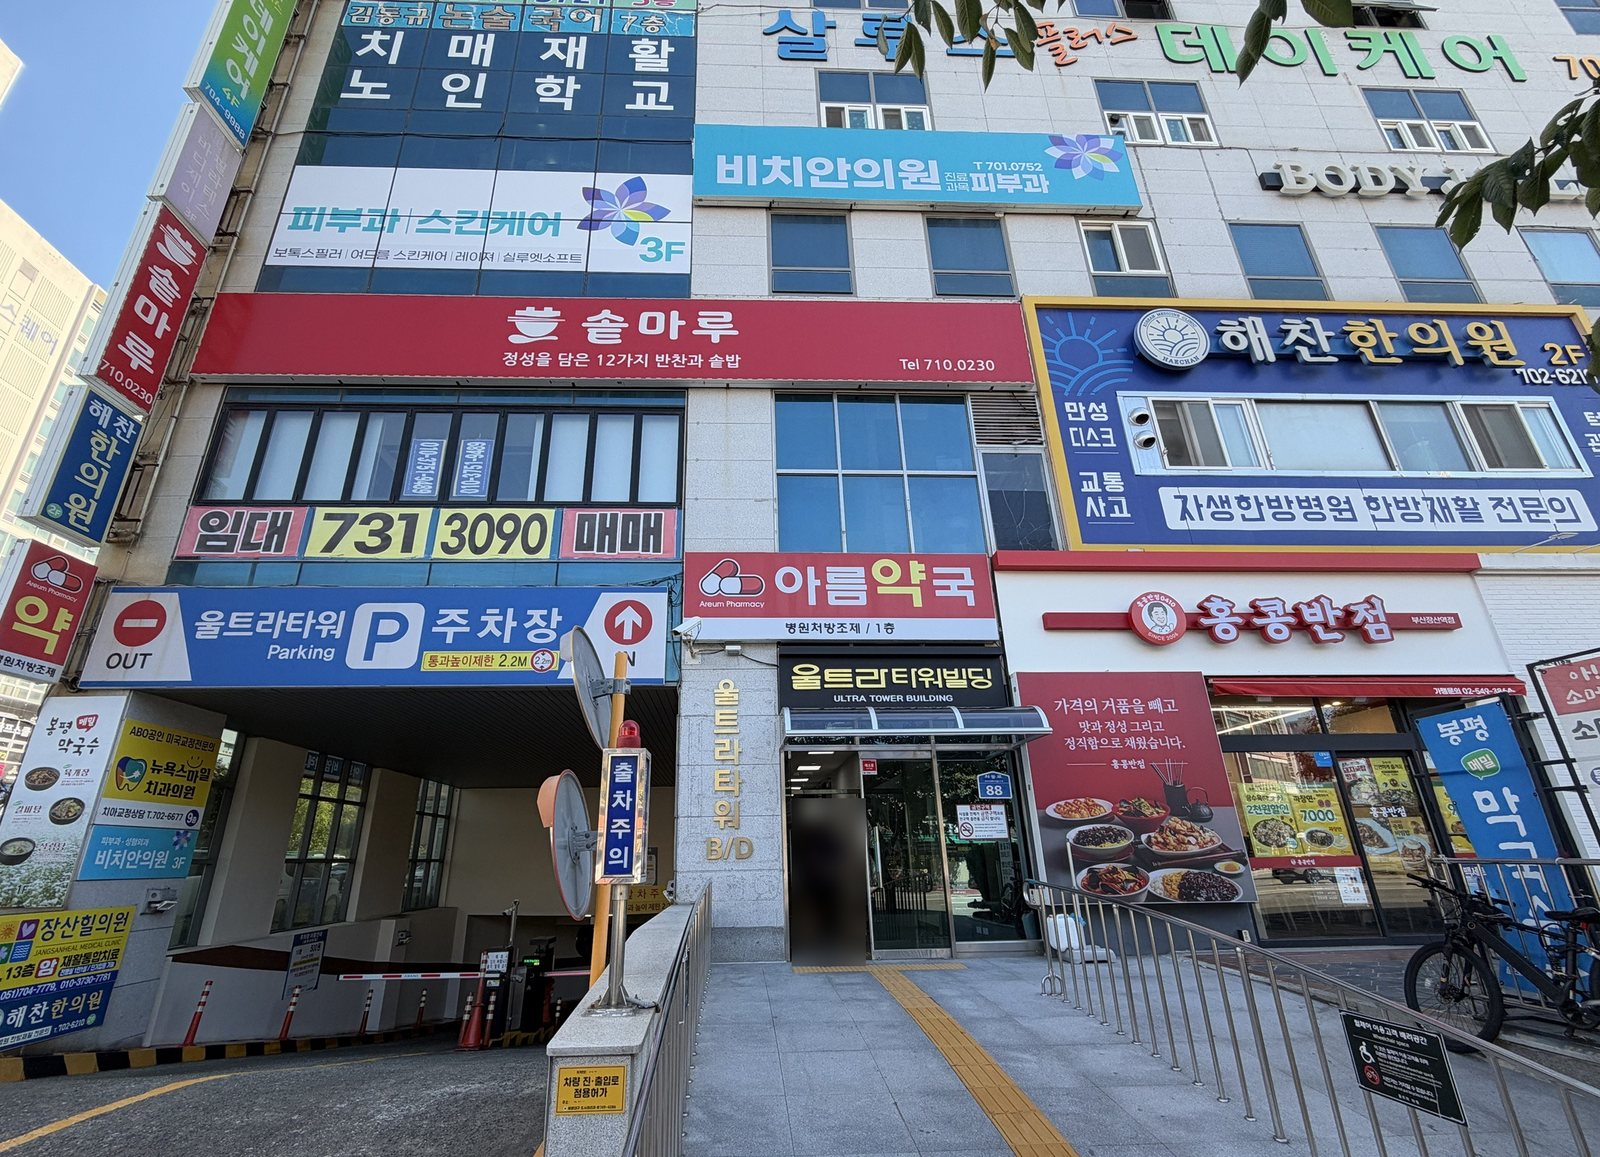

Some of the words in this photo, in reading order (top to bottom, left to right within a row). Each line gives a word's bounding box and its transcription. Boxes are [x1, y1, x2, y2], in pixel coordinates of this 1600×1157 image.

[620, 15, 667, 34] 7층
[1154, 23, 1527, 82] 데이케어
[222, 87, 241, 109] 4F
[716, 154, 941, 191] 비치안의원
[944, 172, 969, 182] 진료
[973, 161, 983, 171] T
[986, 161, 1044, 172] 701.0752
[970, 172, 1050, 194] 피부과
[1272, 160, 1432, 197] BODY
[287, 206, 400, 234] 피부과
[415, 208, 562, 238] 스킨케어
[273, 248, 343, 260] 보톡스필러
[393, 250, 448, 262] 스킨케어
[639, 236, 687, 263] 3F
[118, 264, 182, 375] 솥마루
[581, 308, 740, 345] 솥마루
[502, 351, 553, 367] 정성을
[557, 352, 591, 368] 담은
[597, 353, 649, 369] 12가지
[655, 353, 704, 369] 반찬과
[899, 358, 920, 371] Tel
[924, 359, 996, 372] 710.0230
[1541, 342, 1585, 366] 2F
[100, 359, 154, 405] 710.0230
[1064, 402, 1109, 422] 만성
[1069, 427, 1117, 447] 디스크
[1079, 471, 1124, 493] 교통
[1086, 496, 1131, 518] 사고
[1173, 494, 1358, 523] 자생한방병원
[1363, 495, 1485, 524] 한방재활
[1488, 496, 1582, 524] 전문의
[193, 509, 294, 555] 임대
[321, 511, 421, 555] 731
[440, 512, 549, 556] 3090
[573, 509, 667, 555] 매매
[774, 558, 976, 608] 아름약국
[699, 600, 725, 609] Areum
[726, 600, 765, 609] Pharmacy
[12, 595, 74, 655] 약
[194, 609, 347, 640] 울트라타워
[431, 607, 563, 645] 주차장
[785, 621, 861, 635] 병원처방조제
[876, 622, 895, 634] 1층
[1200, 594, 1395, 643] 홍콩반점
[366, 611, 411, 663] P
[105, 652, 154, 670] OUT
[266, 643, 336, 663] Parking
[427, 653, 494, 668] 통과높이제한
[498, 653, 528, 668] 2.2M
[791, 663, 993, 690] 울트라타워빌딩
[833, 693, 866, 703] ULTRA
[869, 693, 903, 703] TOWER
[906, 693, 954, 703] BUILDING
[1054, 697, 1098, 715] 가격의
[1102, 698, 1145, 715] 거품을
[1148, 698, 1179, 714] 빼고
[46, 717, 73, 736] 봉평
[78, 716, 97, 727] 메밀
[1078, 720, 1102, 734] 맛과
[1104, 720, 1127, 734] 정성
[1130, 720, 1165, 733] 그리고
[1438, 714, 1490, 746] 봉평
[58, 737, 100, 757] 막국수
[129, 726, 164, 743] ABO공인
[166, 733, 215, 752] 미국교정전문의
[1064, 736, 1123, 751] 정직함으로
[1124, 736, 1186, 750] 채웠습니다.
[713, 678, 743, 830] 울트라타워
[1111, 759, 1146, 770] 홍콩반점
[1467, 753, 1496, 772] 메밀
[150, 759, 212, 784] 뉴욕스마일
[144, 780, 196, 800] 치과의원
[986, 785, 1003, 796] 88
[101, 805, 146, 819] 치아교정상담
[147, 811, 184, 821] T.702-6677
[608, 762, 634, 869] 출차주의
[1299, 809, 1336, 822] 7000
[705, 836, 754, 861] B/D
[94, 850, 170, 870] 비치안의원
[171, 857, 187, 870] 3F
[40, 911, 130, 942] 장산힐의원
[80, 941, 104, 952] MEDICAL
[6, 963, 36, 980] 13층
[37, 958, 58, 977] 암
[60, 948, 120, 968] 재활통합치료
[6, 989, 103, 1029] 해찬한의원
[563, 1077, 580, 1087] 차량
[574, 1087, 608, 1098] 점용허가
